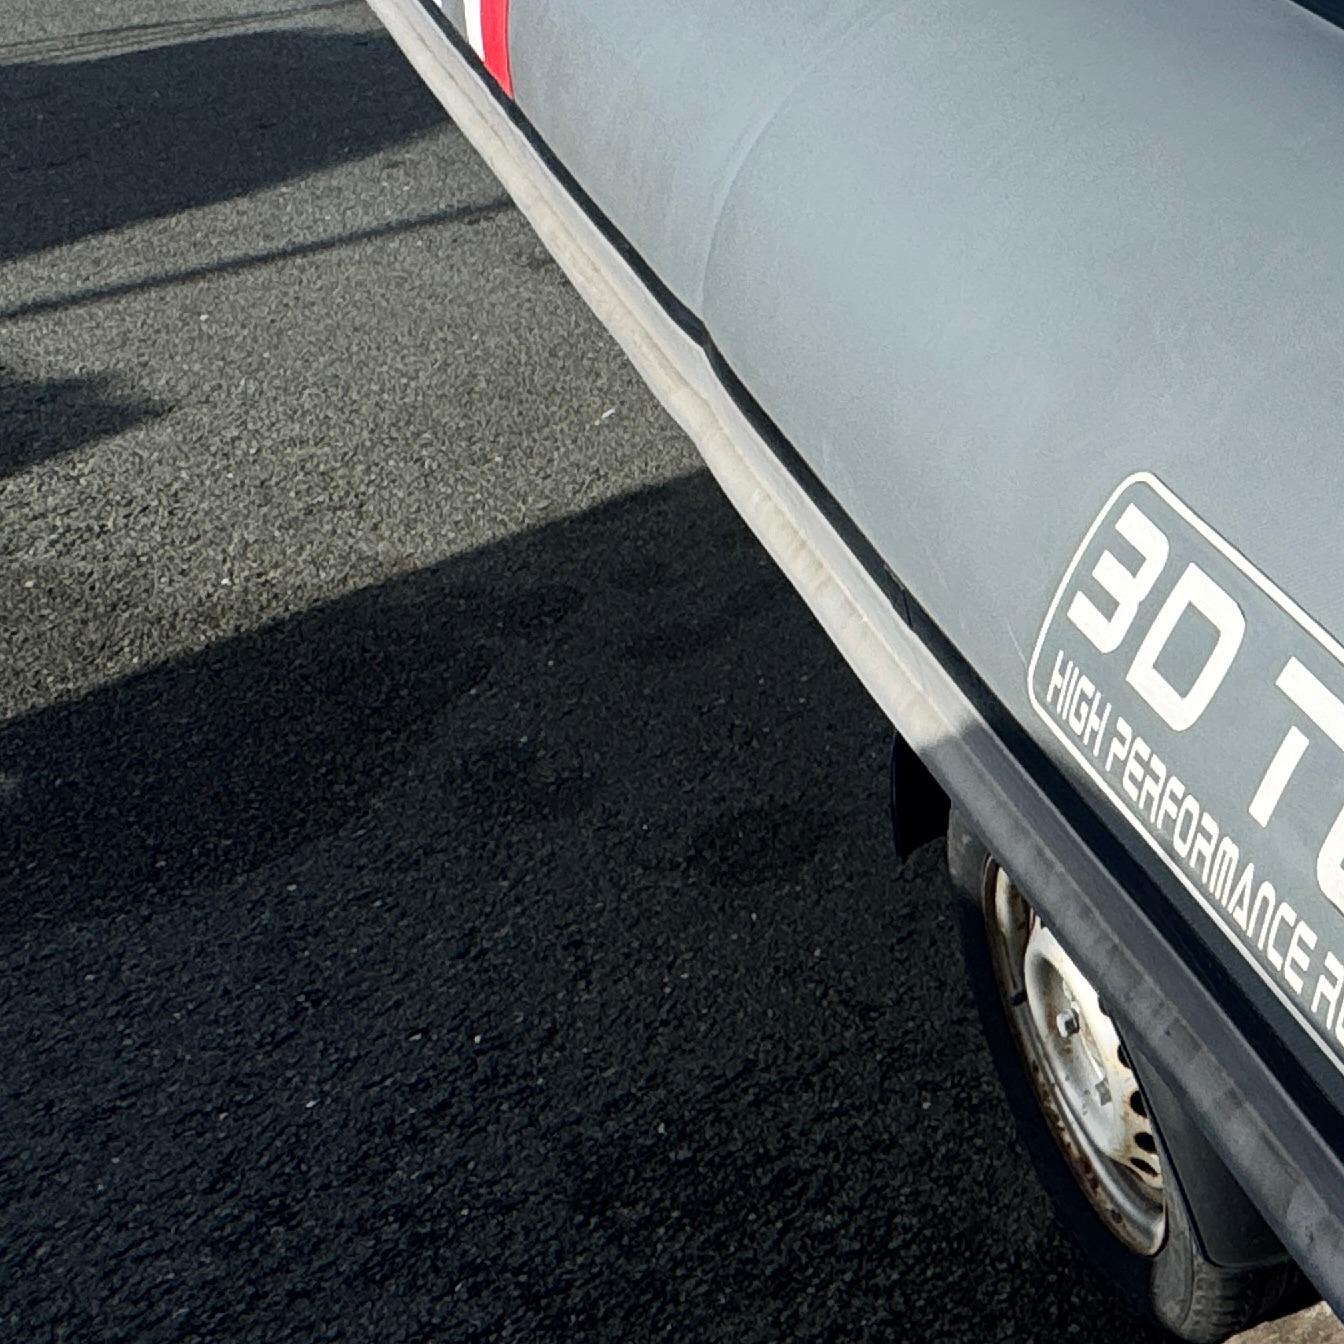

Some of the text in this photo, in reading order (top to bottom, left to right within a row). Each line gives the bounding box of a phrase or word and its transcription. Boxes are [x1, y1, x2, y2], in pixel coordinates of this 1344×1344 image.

[1067, 503, 1246, 732] 3D
[1046, 649, 1112, 757] HIGH
[1105, 716, 1318, 995] PERFORMANCE
